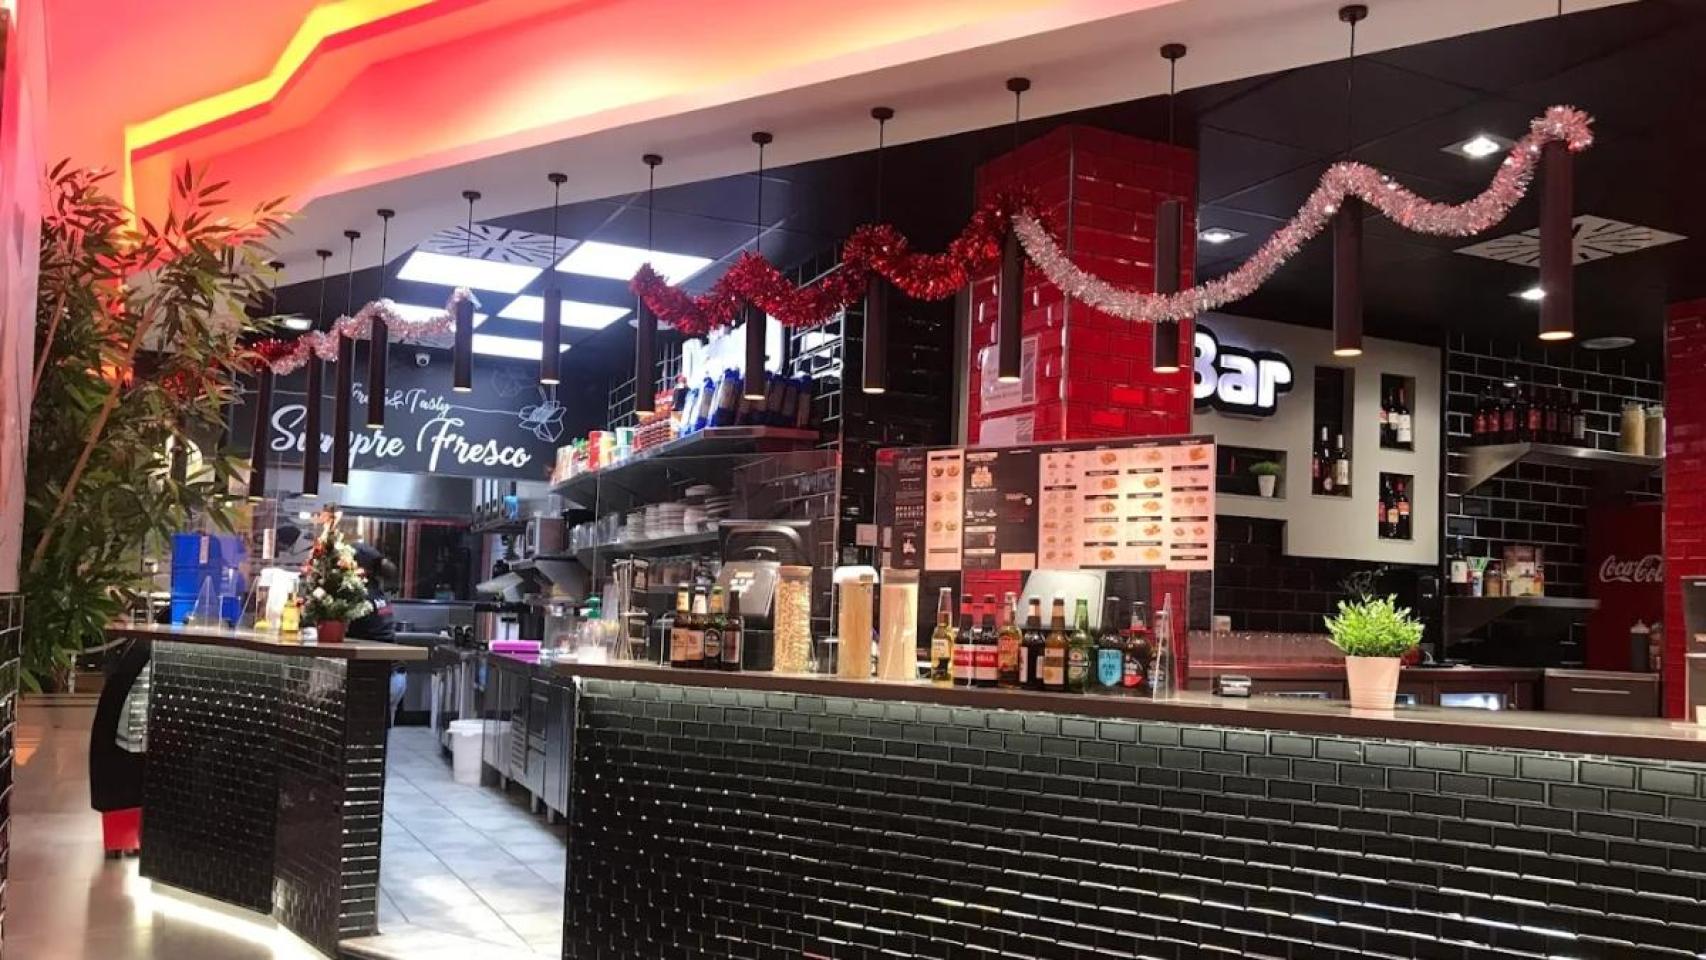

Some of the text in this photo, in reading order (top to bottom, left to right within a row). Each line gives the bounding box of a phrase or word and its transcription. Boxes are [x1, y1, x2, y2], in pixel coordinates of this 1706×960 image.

[1194, 332, 1292, 408] Bar
[270, 404, 532, 472] Sipre Fresco
[1599, 554, 1664, 583] Coca-Col
